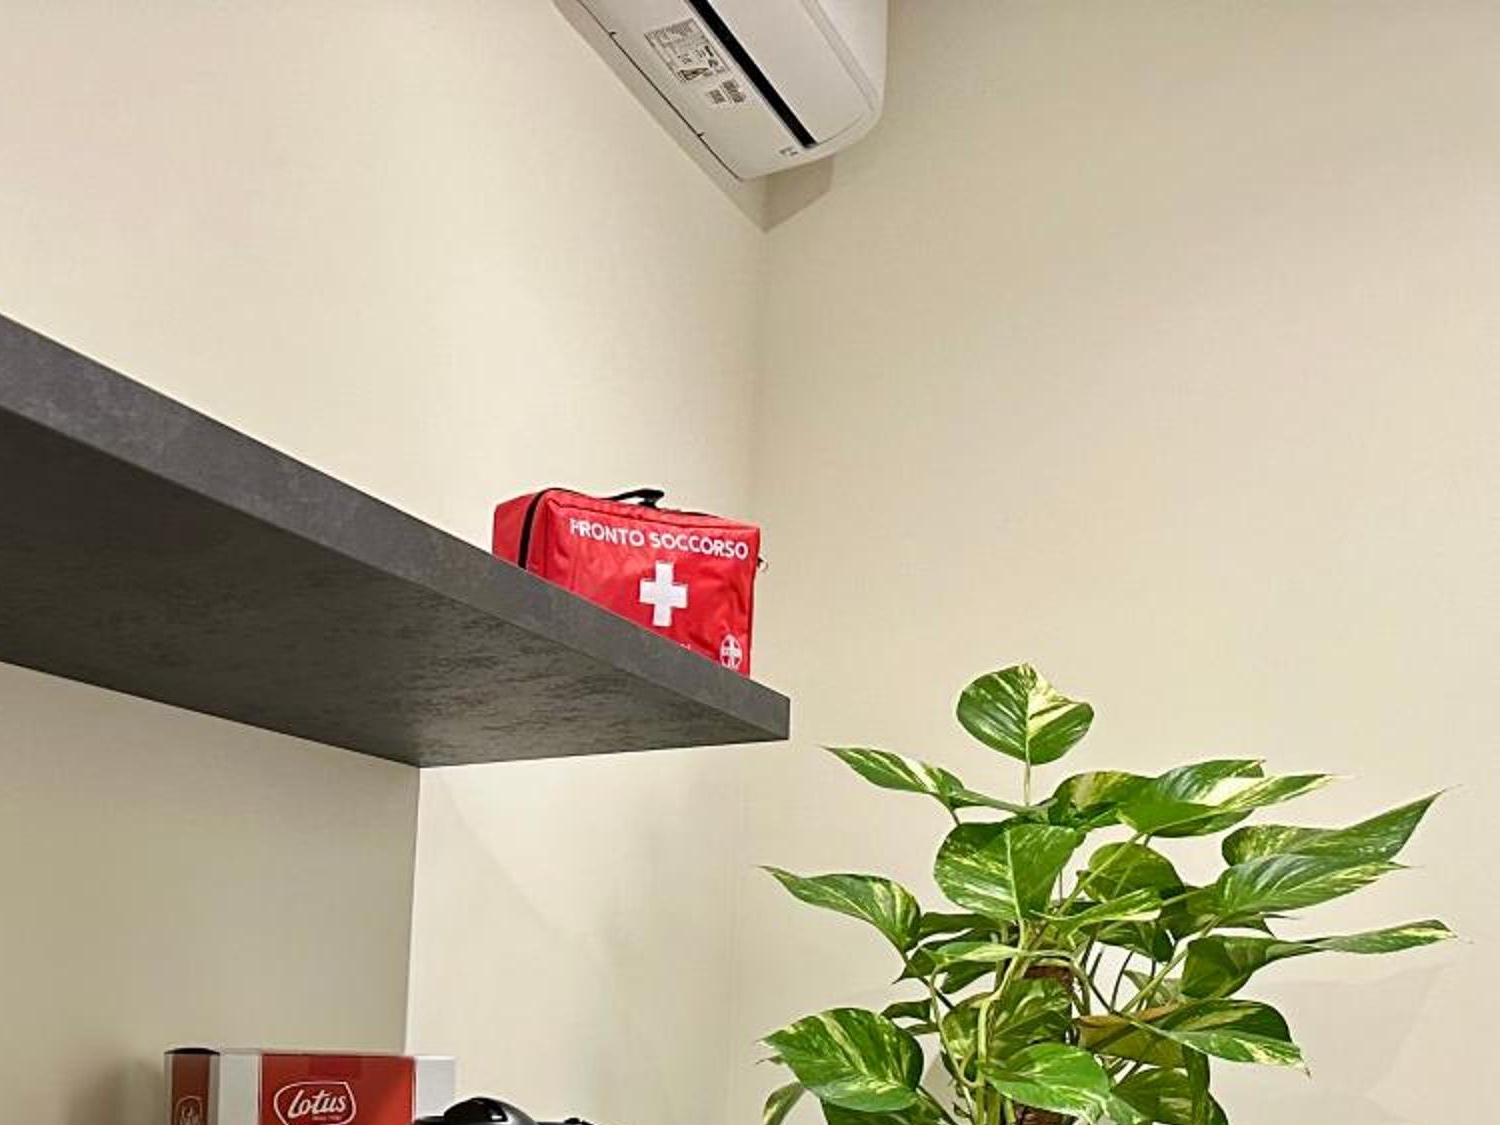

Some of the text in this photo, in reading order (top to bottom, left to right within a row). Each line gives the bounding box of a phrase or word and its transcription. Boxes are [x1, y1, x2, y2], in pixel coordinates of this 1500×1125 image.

[570, 517, 749, 560] PRONTO SOCCORSO
[287, 1089, 347, 1119] Lotus
